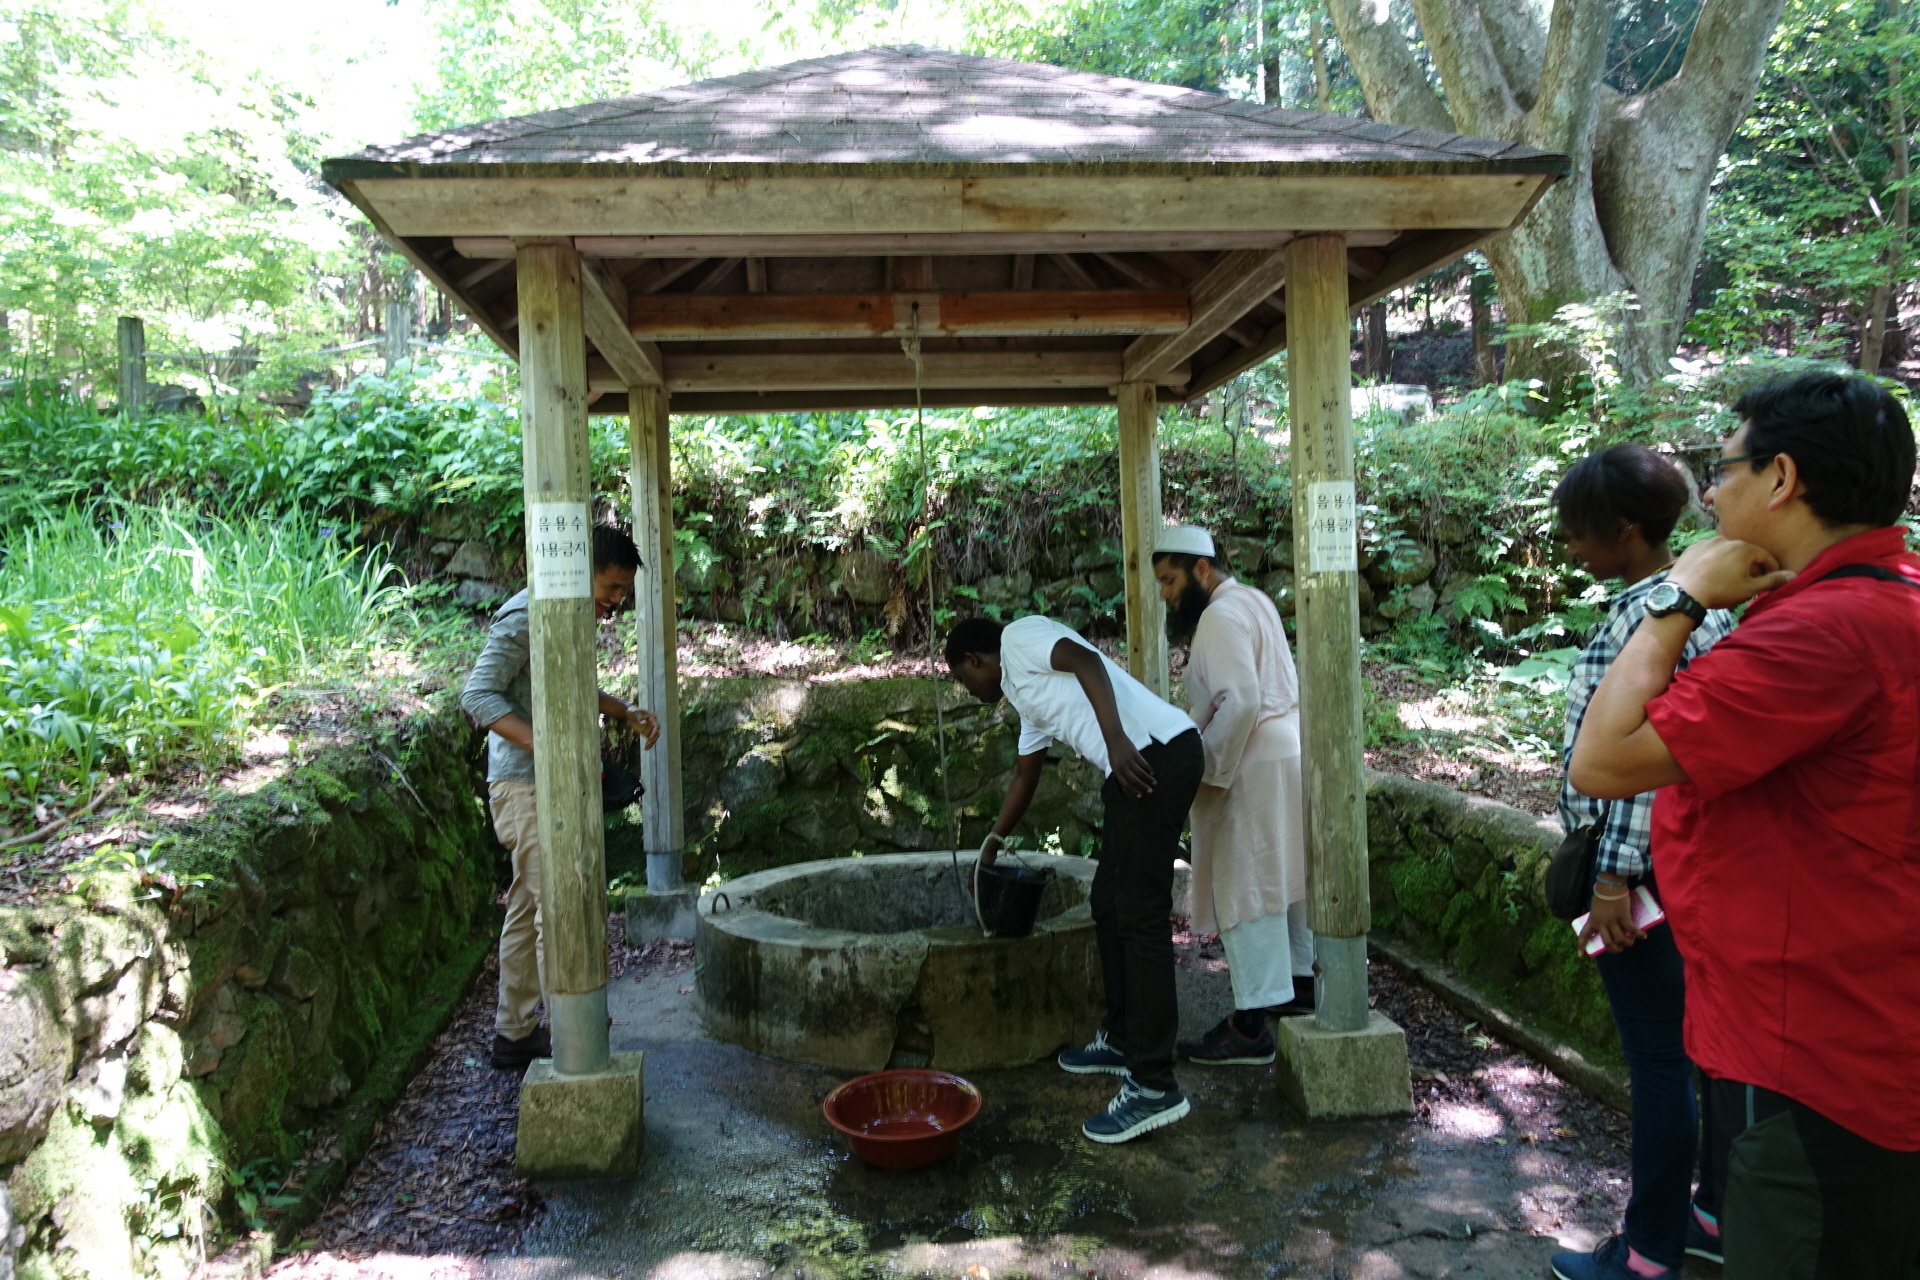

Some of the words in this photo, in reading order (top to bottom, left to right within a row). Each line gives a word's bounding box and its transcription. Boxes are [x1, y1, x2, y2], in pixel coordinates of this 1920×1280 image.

[1317, 493, 1353, 510] 음용수
[539, 515, 584, 532] 음용수
[535, 541, 586, 558] 사용금지
